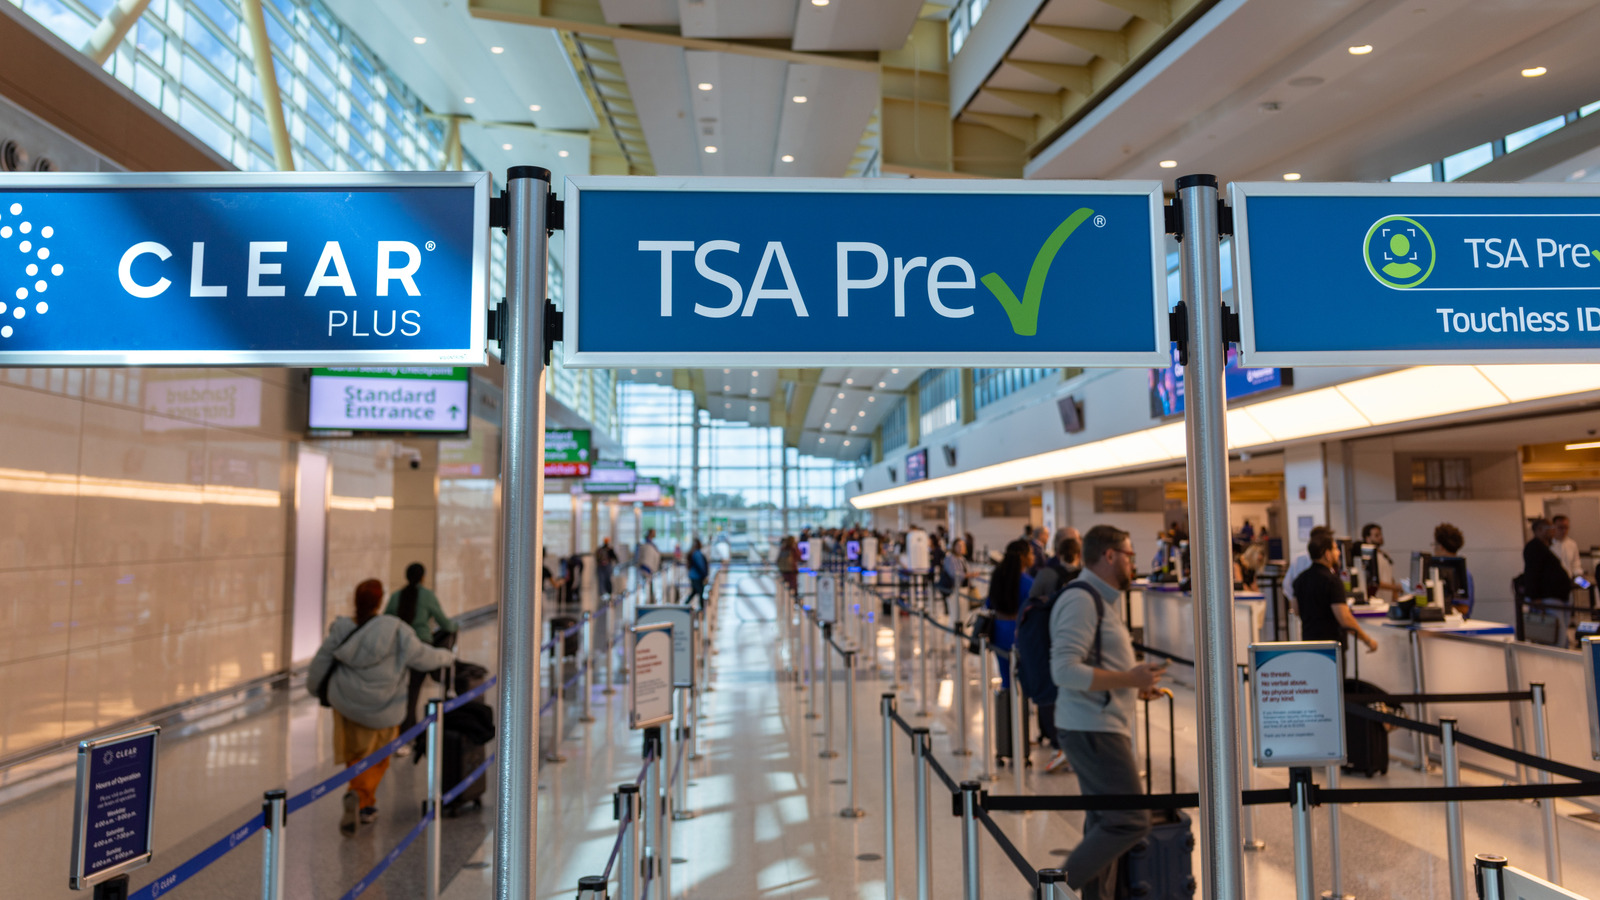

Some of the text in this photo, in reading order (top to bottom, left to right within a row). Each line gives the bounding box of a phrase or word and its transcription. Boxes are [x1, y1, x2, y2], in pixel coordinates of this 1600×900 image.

[1464, 238, 1591, 268] TSA Pre
[638, 239, 809, 319] TSA
[328, 309, 422, 337] PLUS
[1436, 306, 1570, 333] Touchless
[344, 386, 437, 404] Standard
[345, 401, 435, 420] Entrance
[116, 746, 137, 759] CLEAR
